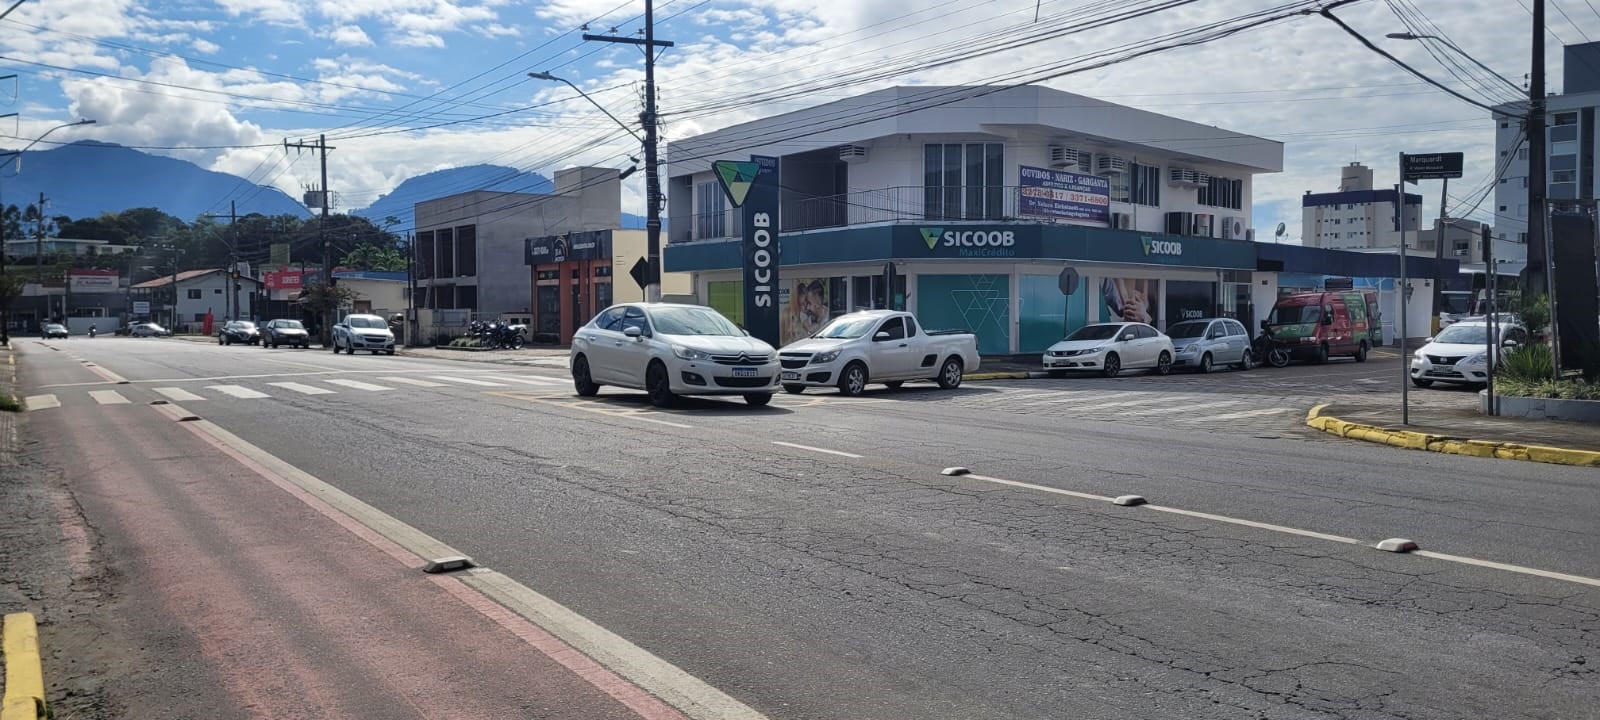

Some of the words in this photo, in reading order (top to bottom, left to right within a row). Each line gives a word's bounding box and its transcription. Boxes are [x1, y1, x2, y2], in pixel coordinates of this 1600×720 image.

[1022, 168, 1050, 180] OUVIDOS
[1055, 173, 1073, 184] NARIZ
[1078, 177, 1107, 188] GARGANTA
[944, 231, 1015, 246] SICOOB
[1151, 240, 1182, 255] SICOOB
[754, 212, 771, 307] SICOOB
